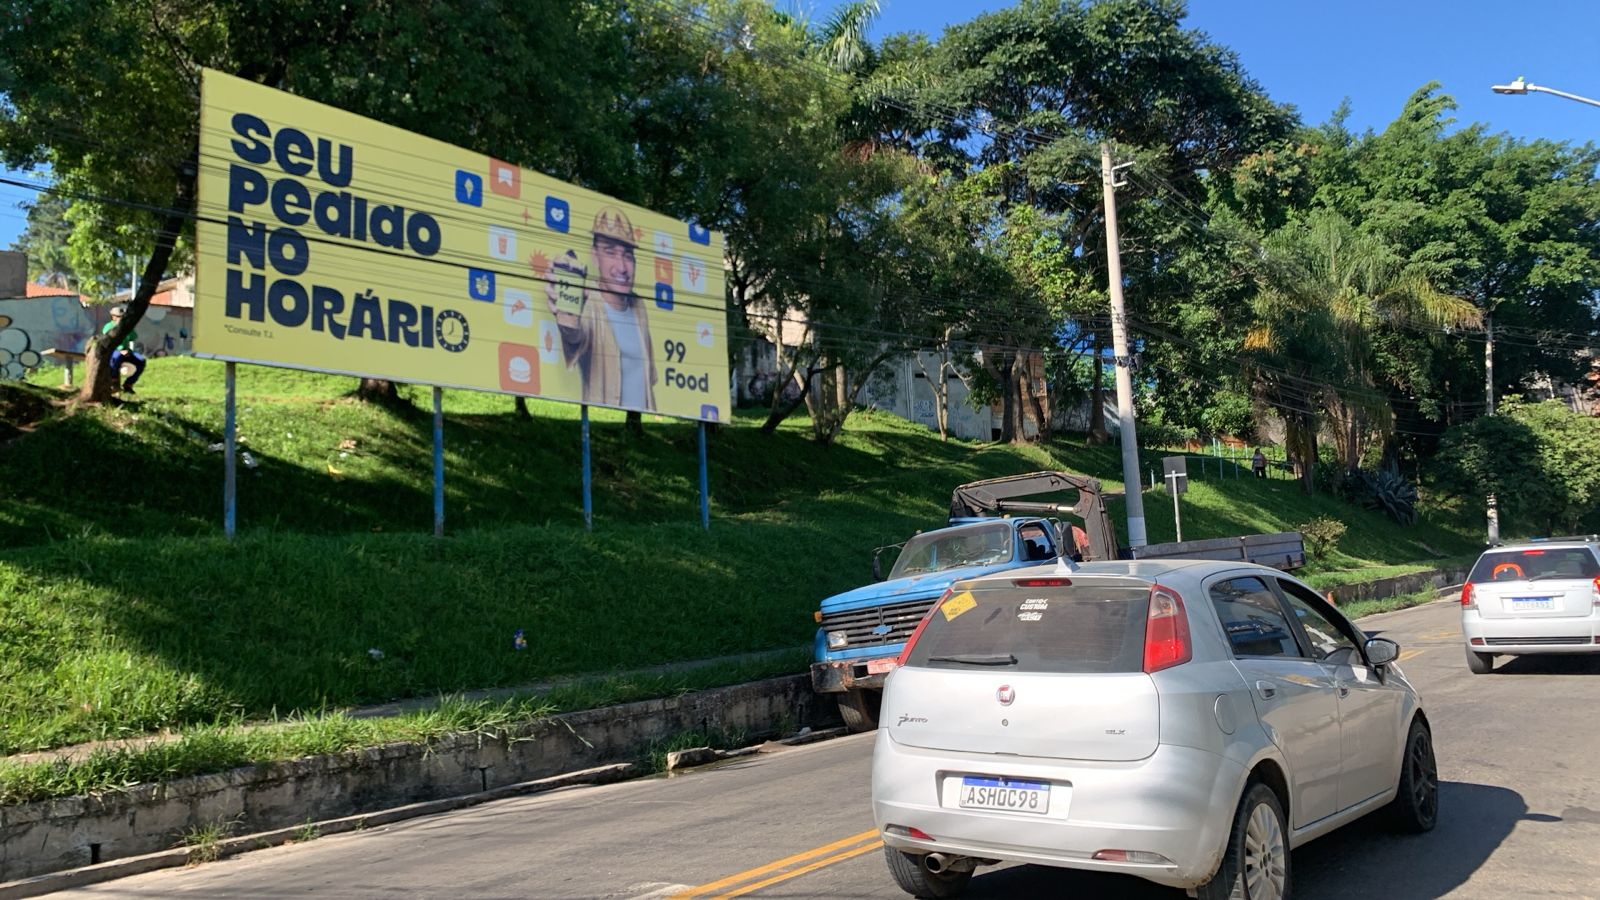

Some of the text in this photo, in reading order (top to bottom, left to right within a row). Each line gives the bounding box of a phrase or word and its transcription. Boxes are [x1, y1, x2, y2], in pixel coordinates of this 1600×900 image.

[226, 215, 309, 276] NO
[664, 339, 686, 363] 99
[665, 367, 709, 393] Food
